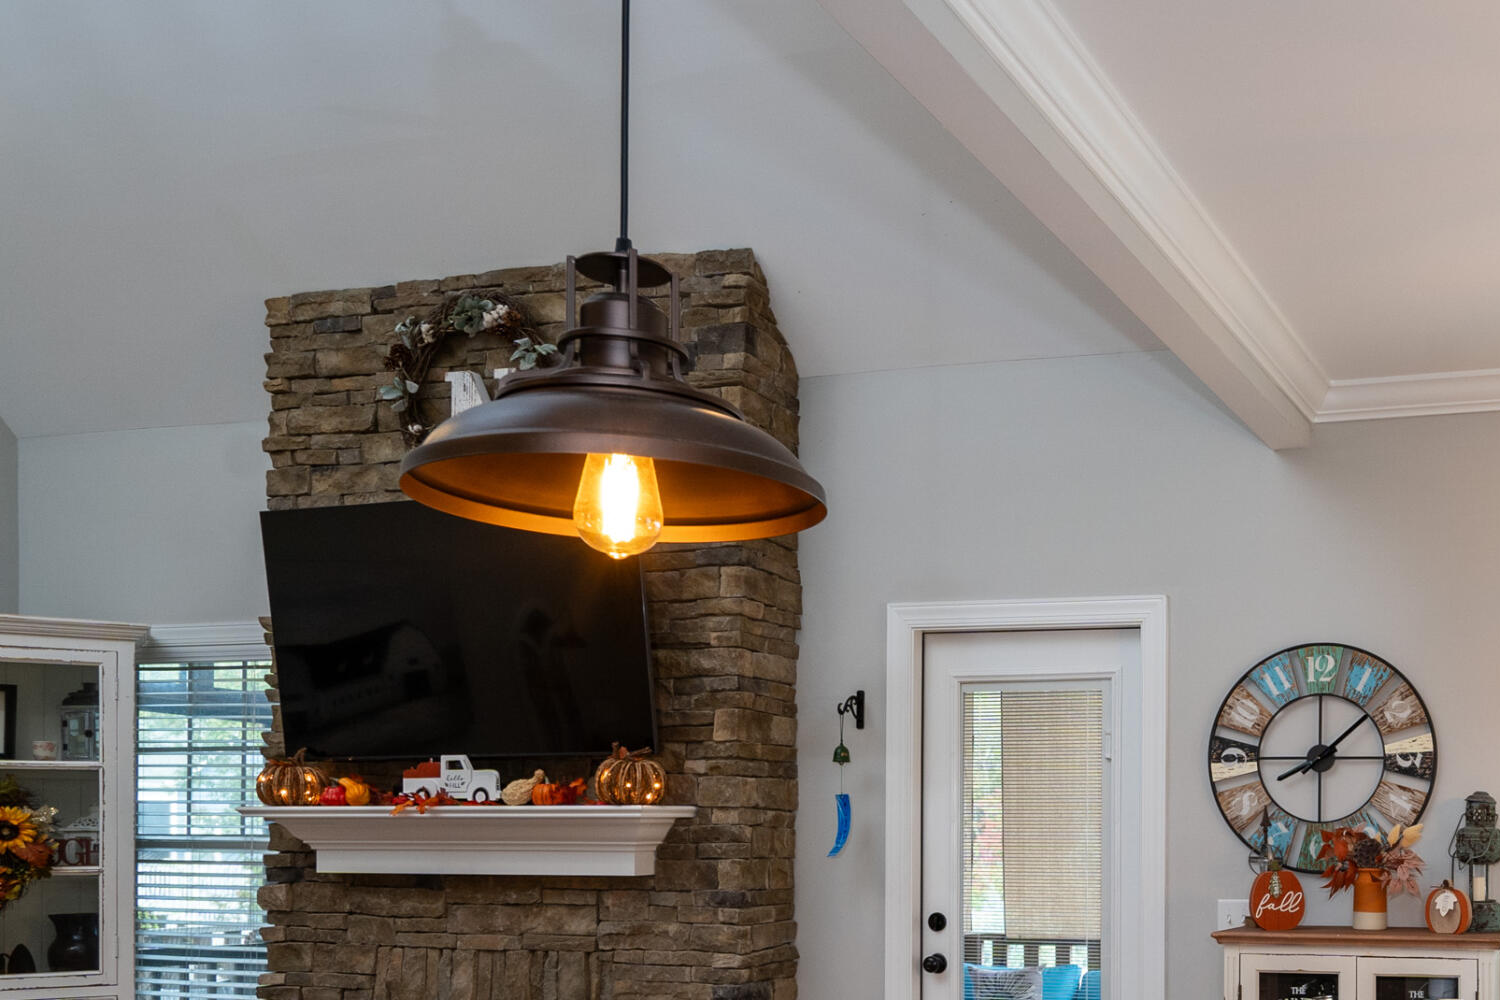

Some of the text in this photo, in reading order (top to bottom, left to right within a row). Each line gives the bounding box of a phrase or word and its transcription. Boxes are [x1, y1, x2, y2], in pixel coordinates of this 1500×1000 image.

[1262, 665, 1292, 696] 11
[1306, 654, 1336, 683] 12
[1354, 666, 1373, 693] 1
[1230, 698, 1261, 729] 10
[1383, 699, 1413, 724] 2
[1256, 891, 1303, 919] fall
[1290, 986, 1308, 995] THE
[1408, 990, 1425, 999] THE
